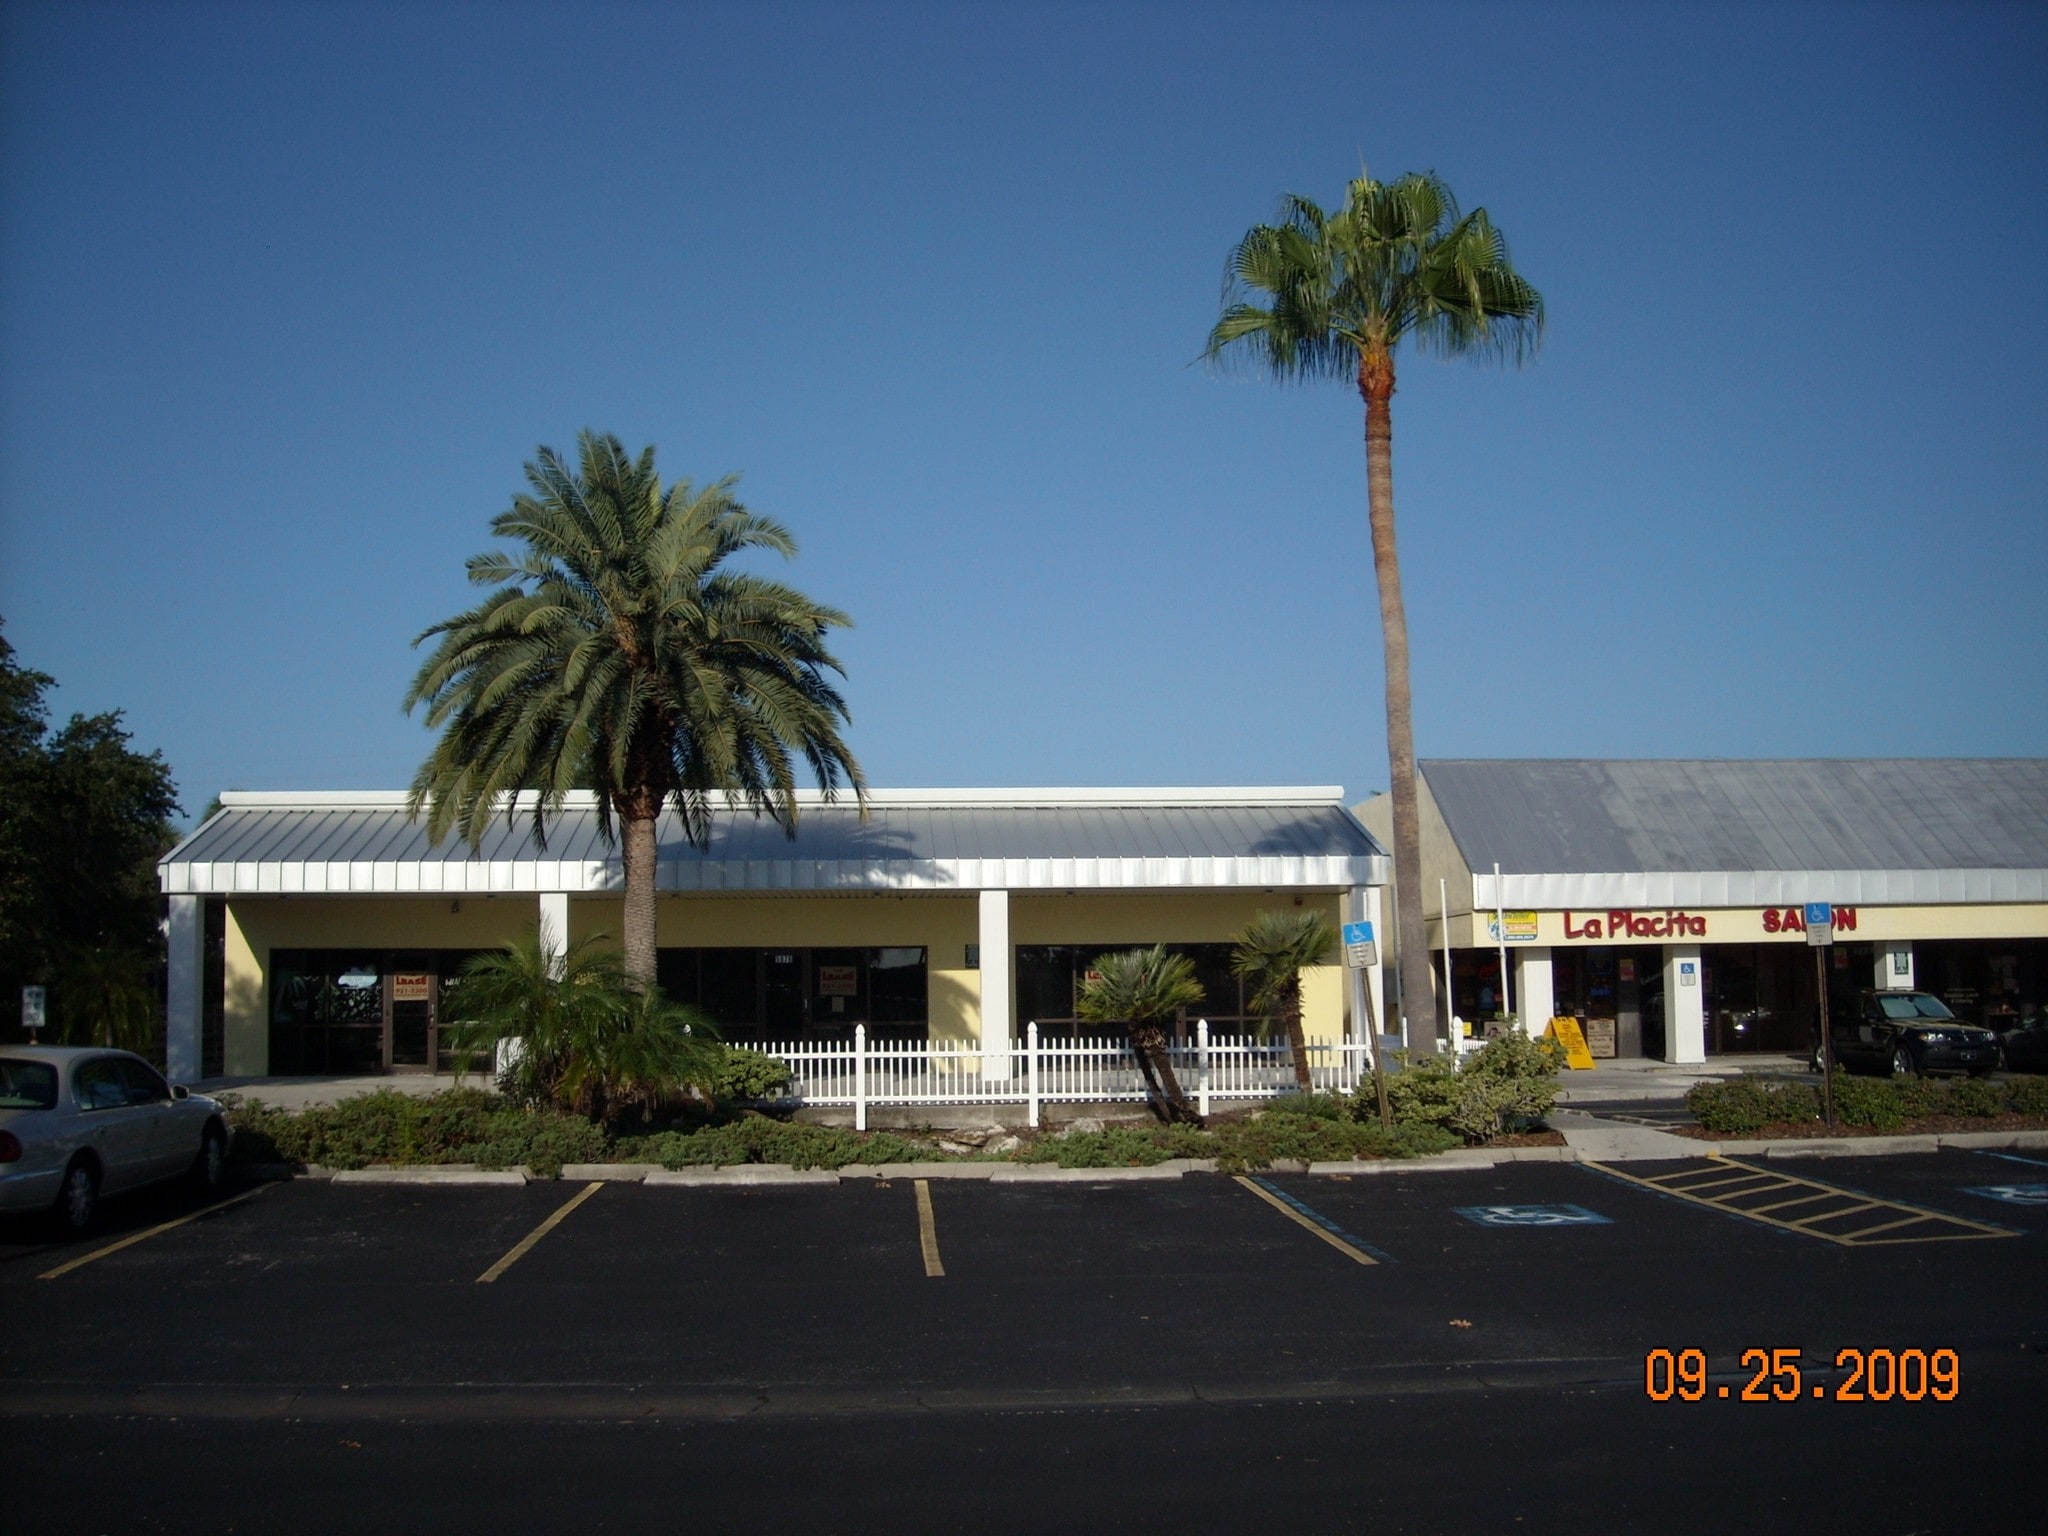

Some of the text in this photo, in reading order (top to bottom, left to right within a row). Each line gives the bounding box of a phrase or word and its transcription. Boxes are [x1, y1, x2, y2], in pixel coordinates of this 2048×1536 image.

[1564, 910, 1706, 939] La Placita
[1762, 907, 1857, 933] SAN
[396, 975, 427, 985] LEASE
